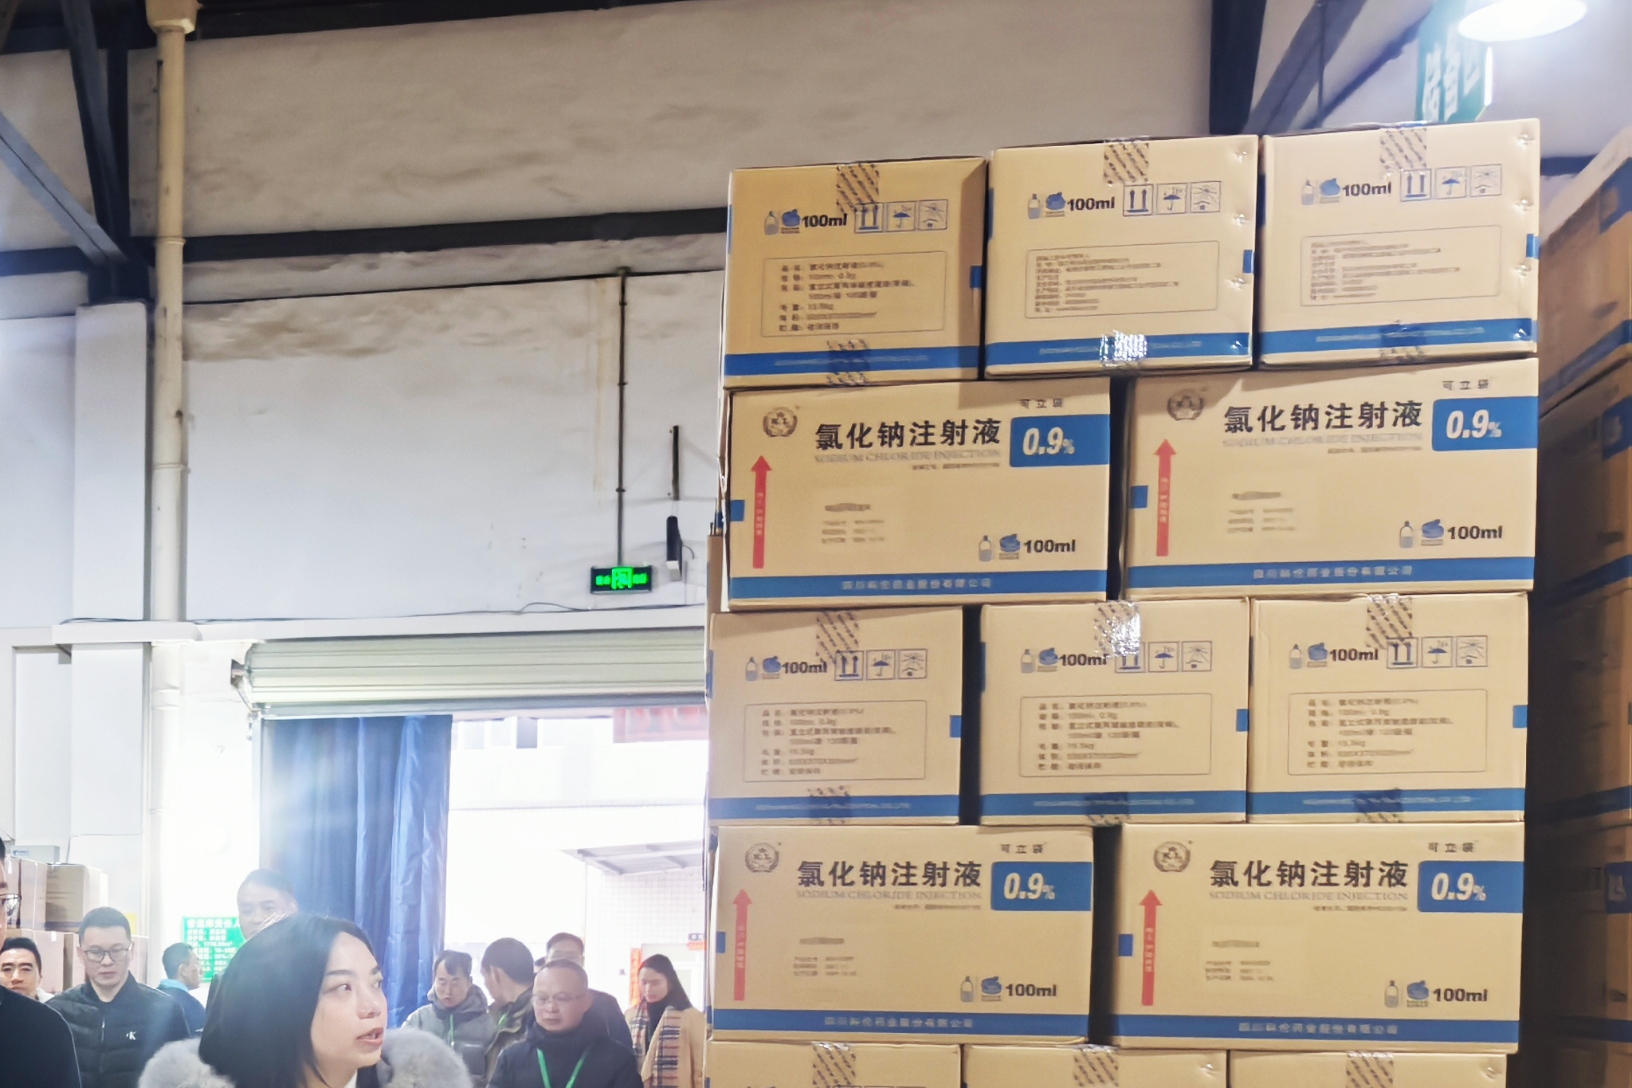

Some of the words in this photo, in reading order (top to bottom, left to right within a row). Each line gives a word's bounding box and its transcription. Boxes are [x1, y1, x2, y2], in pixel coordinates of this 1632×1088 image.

[1343, 180, 1392, 197] 100ml
[1067, 196, 1115, 212] 100ml
[802, 213, 847, 228] 100ml
[1223, 400, 1423, 433] 氯化钠注射液
[1446, 410, 1502, 439] 0.9%
[815, 418, 1001, 450] 氯化钠注射液
[1022, 427, 1074, 455] 0.9%
[1447, 524, 1503, 540] 100ml
[1023, 539, 1076, 554] 100ml
[1329, 648, 1379, 662] 100ml
[782, 661, 827, 675] 100ml
[797, 860, 982, 888] 氯化钠注射液
[1210, 860, 1408, 888] 氯化钠注射液
[1004, 872, 1056, 900] 0.9%
[1431, 872, 1487, 901] 0.9%
[1006, 983, 1057, 997] 100ml
[1432, 988, 1488, 1003] 100ml
